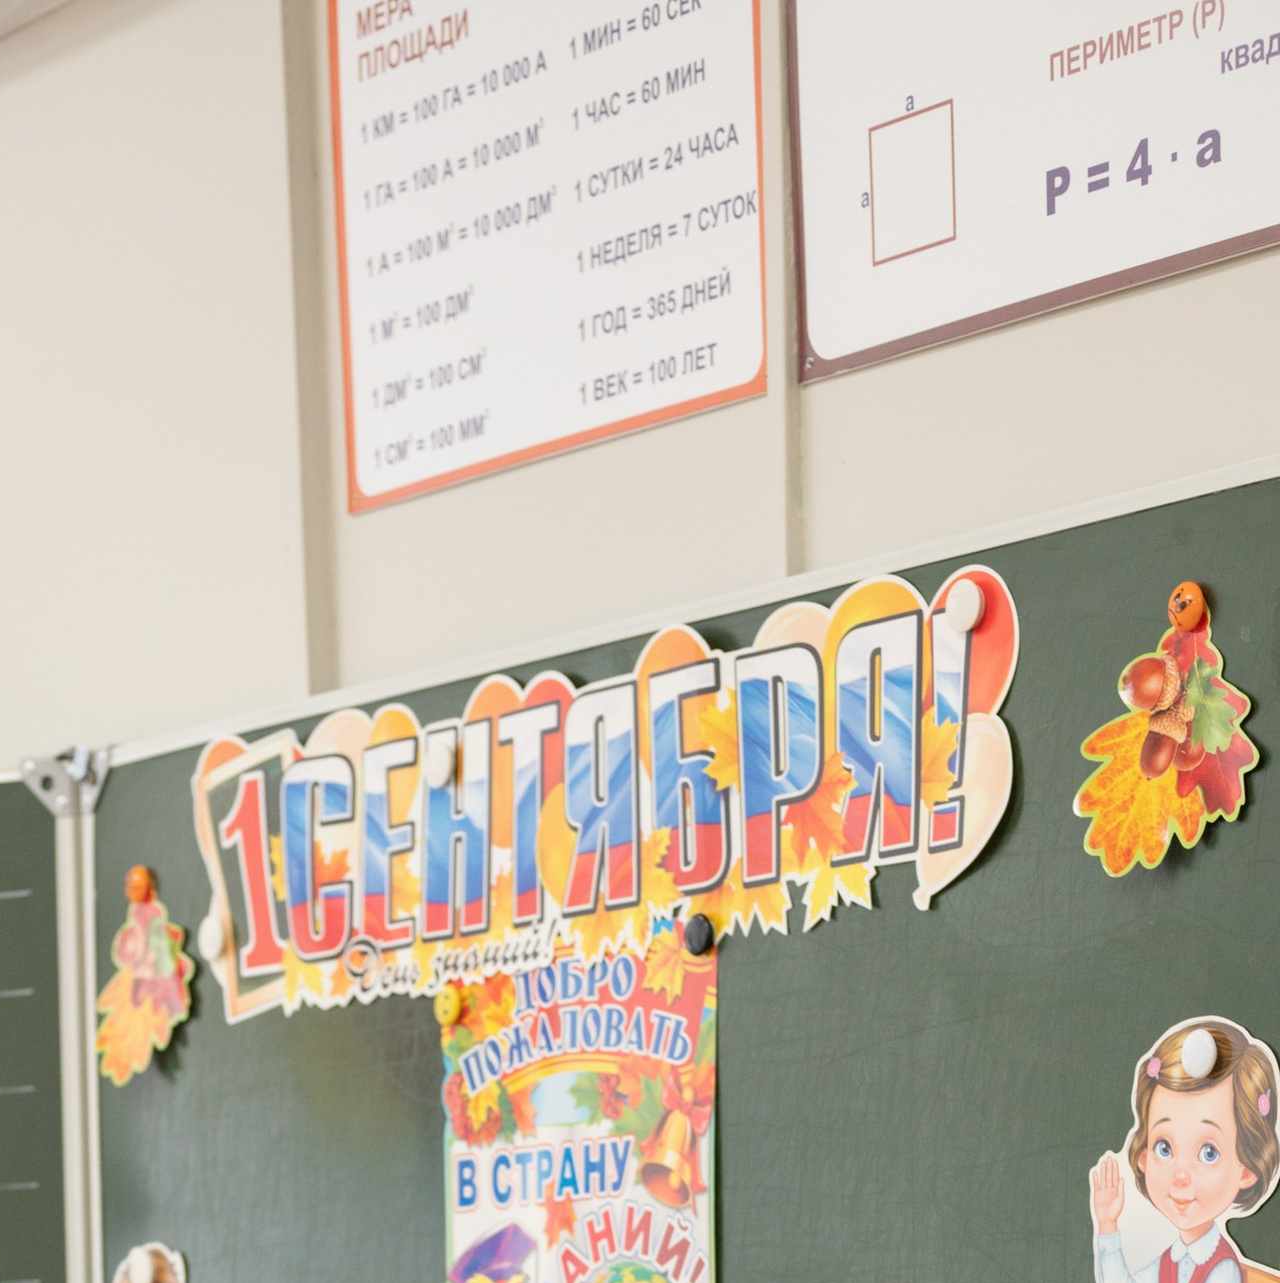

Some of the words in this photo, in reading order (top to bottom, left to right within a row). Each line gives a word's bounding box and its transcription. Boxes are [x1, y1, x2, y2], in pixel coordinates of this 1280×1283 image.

[357, 0, 414, 39] МЕРА
[358, 9, 469, 82] ПЛОЩАДИ
[570, 37, 577, 60] 1
[583, 18, 621, 55] МИН
[627, 19, 636, 32] =
[642, 3, 660, 31] 60
[1050, 9, 1184, 82] ПЕРИМЕТР
[361, 123, 368, 143] 1
[414, 95, 438, 123] 100
[443, 86, 463, 111] ГА
[535, 50, 547, 74] А
[572, 107, 579, 131] 1
[586, 91, 621, 123] ЧАС
[627, 91, 636, 104] =
[641, 77, 660, 104] 60
[666, 58, 706, 95] МИН
[364, 190, 371, 211] 1
[375, 182, 395, 206] ГА
[413, 164, 438, 191] 100
[442, 158, 454, 181] А
[574, 179, 582, 202] 1
[588, 157, 644, 197] СУТКИ
[649, 157, 658, 170] =
[664, 142, 683, 171] 24
[689, 122, 739, 159] ЧАСА
[1087, 161, 1109, 193] =
[1126, 137, 1152, 187] 4
[367, 257, 373, 278] 1
[378, 252, 390, 274] А
[408, 236, 433, 262] 100
[576, 250, 584, 273] 1
[589, 223, 662, 269] НЕДЕЛЯ
[668, 224, 677, 236] =
[683, 213, 692, 237] 7
[698, 190, 757, 231] СУТОК
[417, 301, 441, 327] 100
[578, 318, 585, 341] 1
[592, 306, 628, 338] ГОД
[633, 306, 642, 319] =
[647, 290, 677, 320] 365
[681, 266, 731, 314] ДНЕЙ
[429, 362, 453, 389] 100
[580, 382, 587, 405] 1
[593, 370, 628, 402] ВЕК
[633, 372, 642, 384] =
[649, 356, 677, 385] 100
[682, 342, 718, 376] ЛЕТ
[431, 424, 455, 451] 100
[514, 955, 634, 1017] ДОБРО
[460, 1007, 692, 1094] ПОЖАЛОВАТЬ
[458, 1159, 477, 1207] В
[493, 1139, 631, 1204] СТРАНУ
